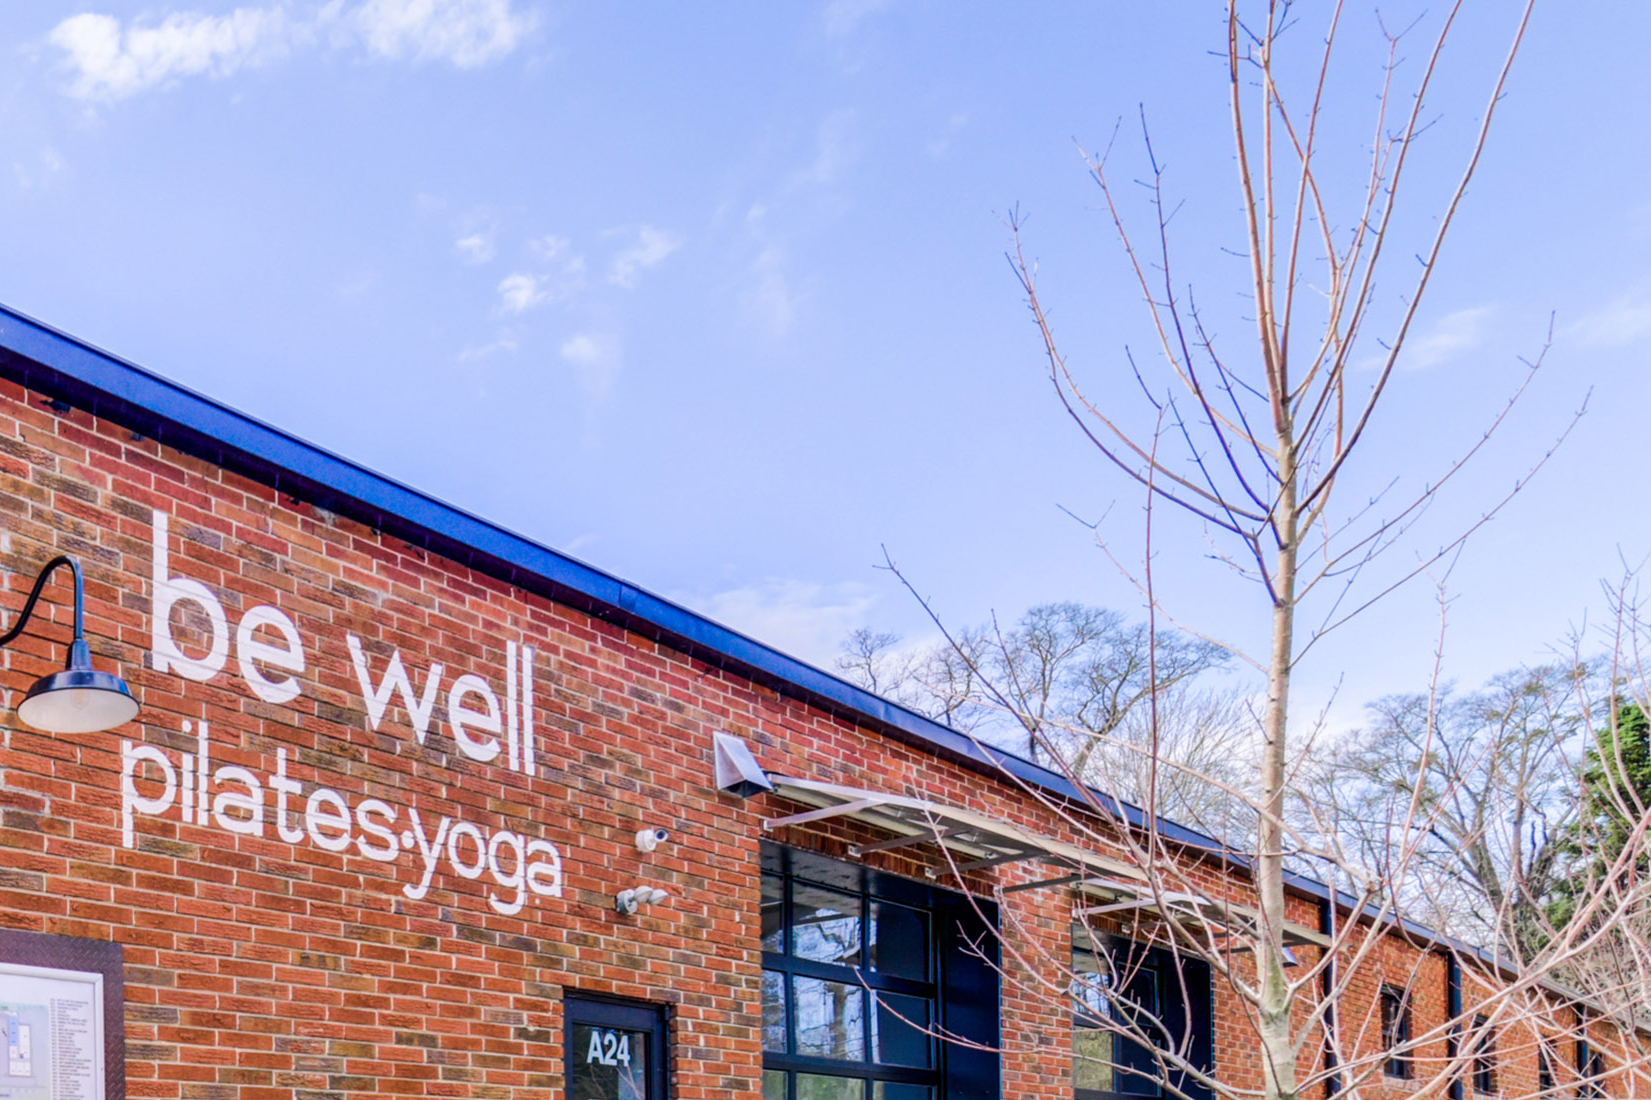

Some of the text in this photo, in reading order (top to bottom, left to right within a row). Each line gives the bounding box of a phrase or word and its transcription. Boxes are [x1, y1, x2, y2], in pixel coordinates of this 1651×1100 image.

[152, 510, 535, 776] be well
[586, 1030, 631, 1068] A24
